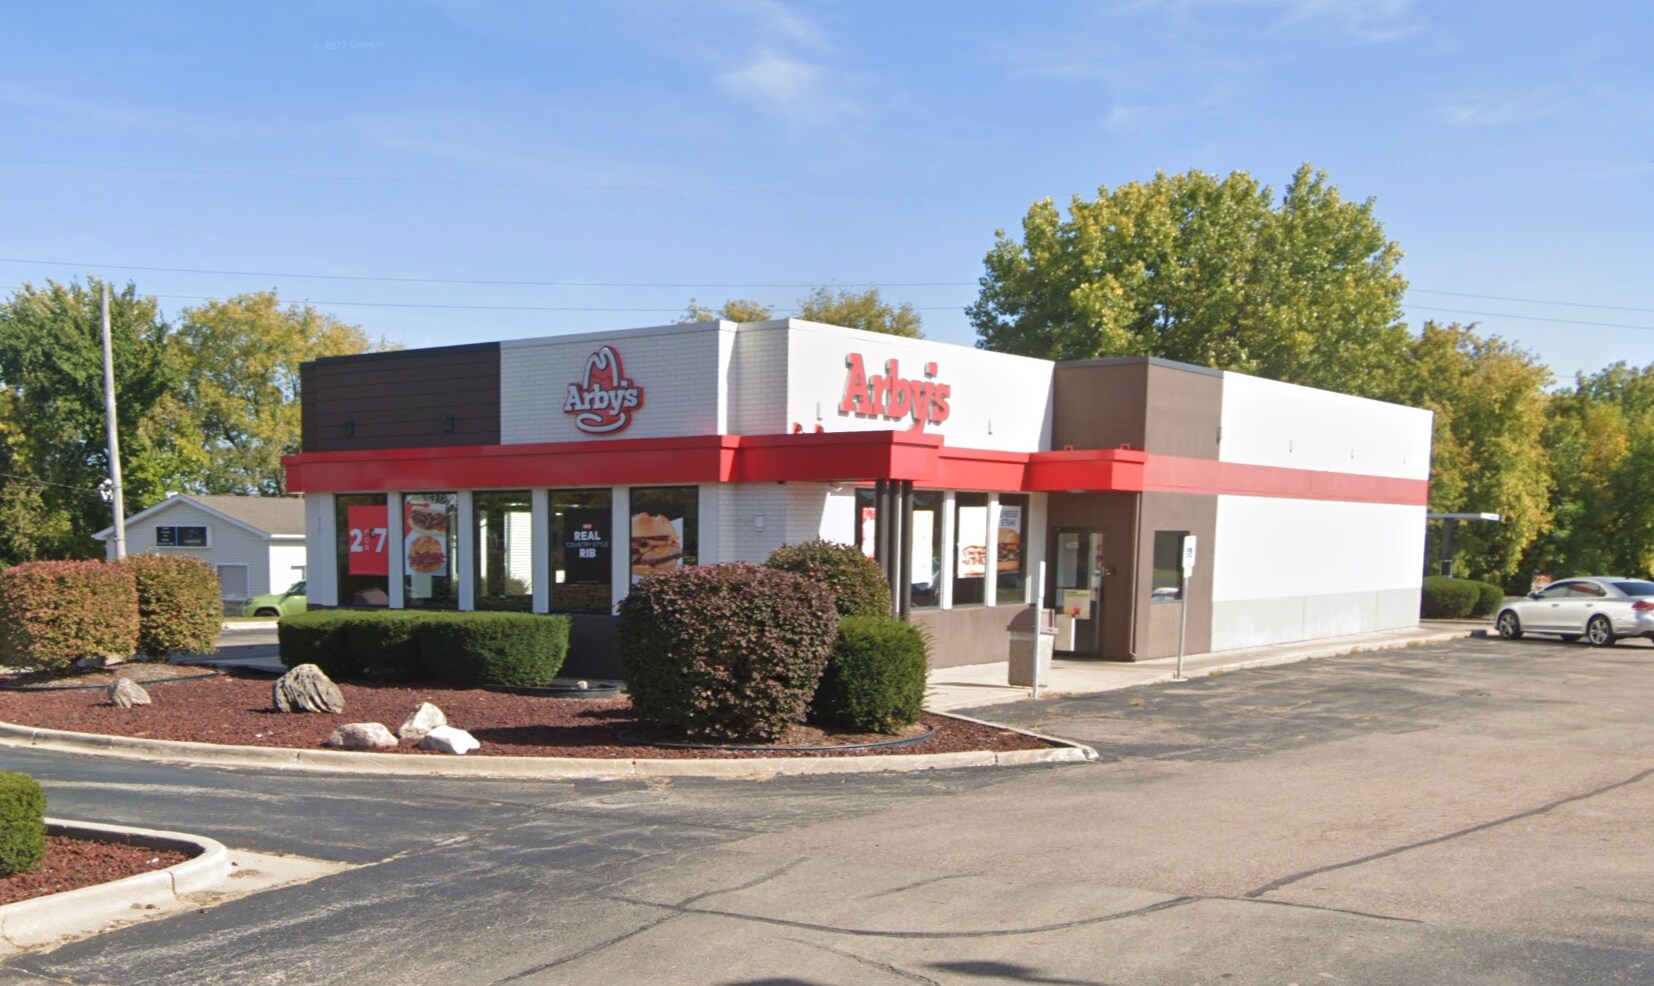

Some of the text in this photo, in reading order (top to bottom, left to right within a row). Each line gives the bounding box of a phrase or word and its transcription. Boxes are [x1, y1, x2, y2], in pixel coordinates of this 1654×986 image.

[563, 379, 639, 417] Arby's
[838, 352, 952, 433] Arby's
[349, 528, 363, 552] 2
[574, 530, 602, 541] REAL
[579, 548, 596, 558] RIB
